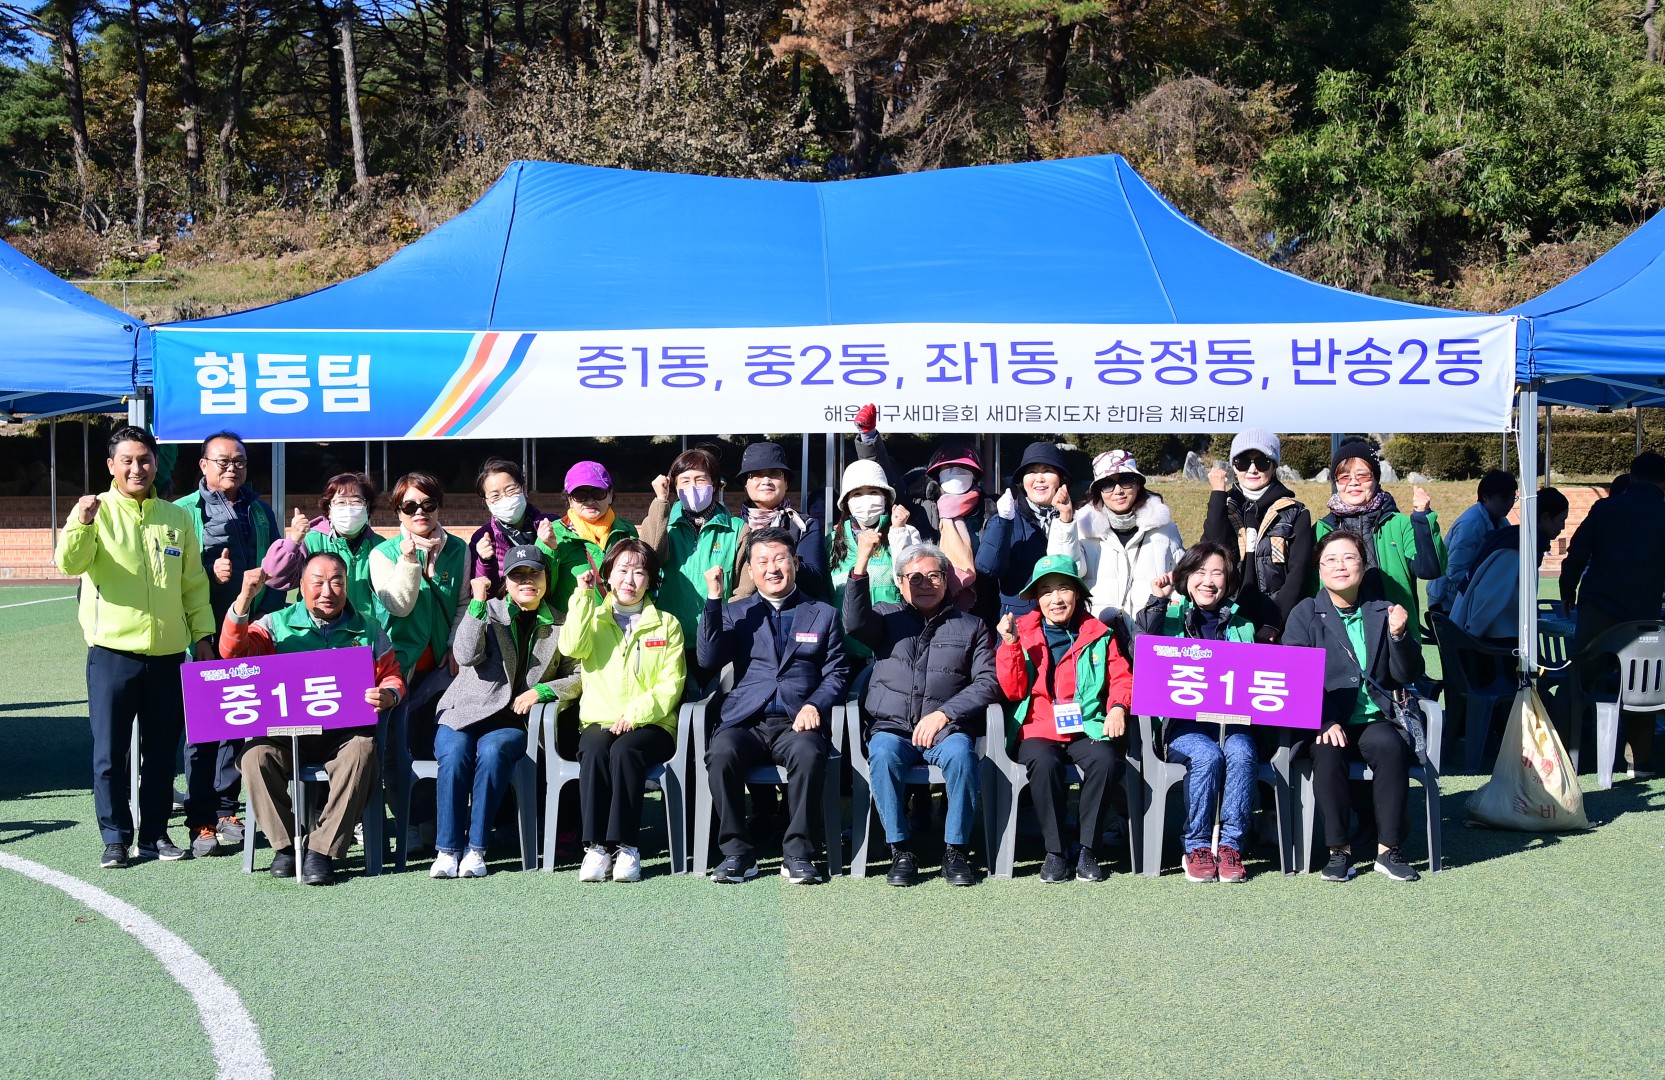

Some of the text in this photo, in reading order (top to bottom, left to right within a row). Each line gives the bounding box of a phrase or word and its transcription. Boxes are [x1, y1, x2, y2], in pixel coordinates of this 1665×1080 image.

[194, 351, 371, 415] 협동팀
[576, 337, 1484, 392] 중1동, 중2동, 좌1동, 송정동, 반송2동
[823, 404, 1245, 423] 해운구새마을회 새마을지도자 한마음 체육대회
